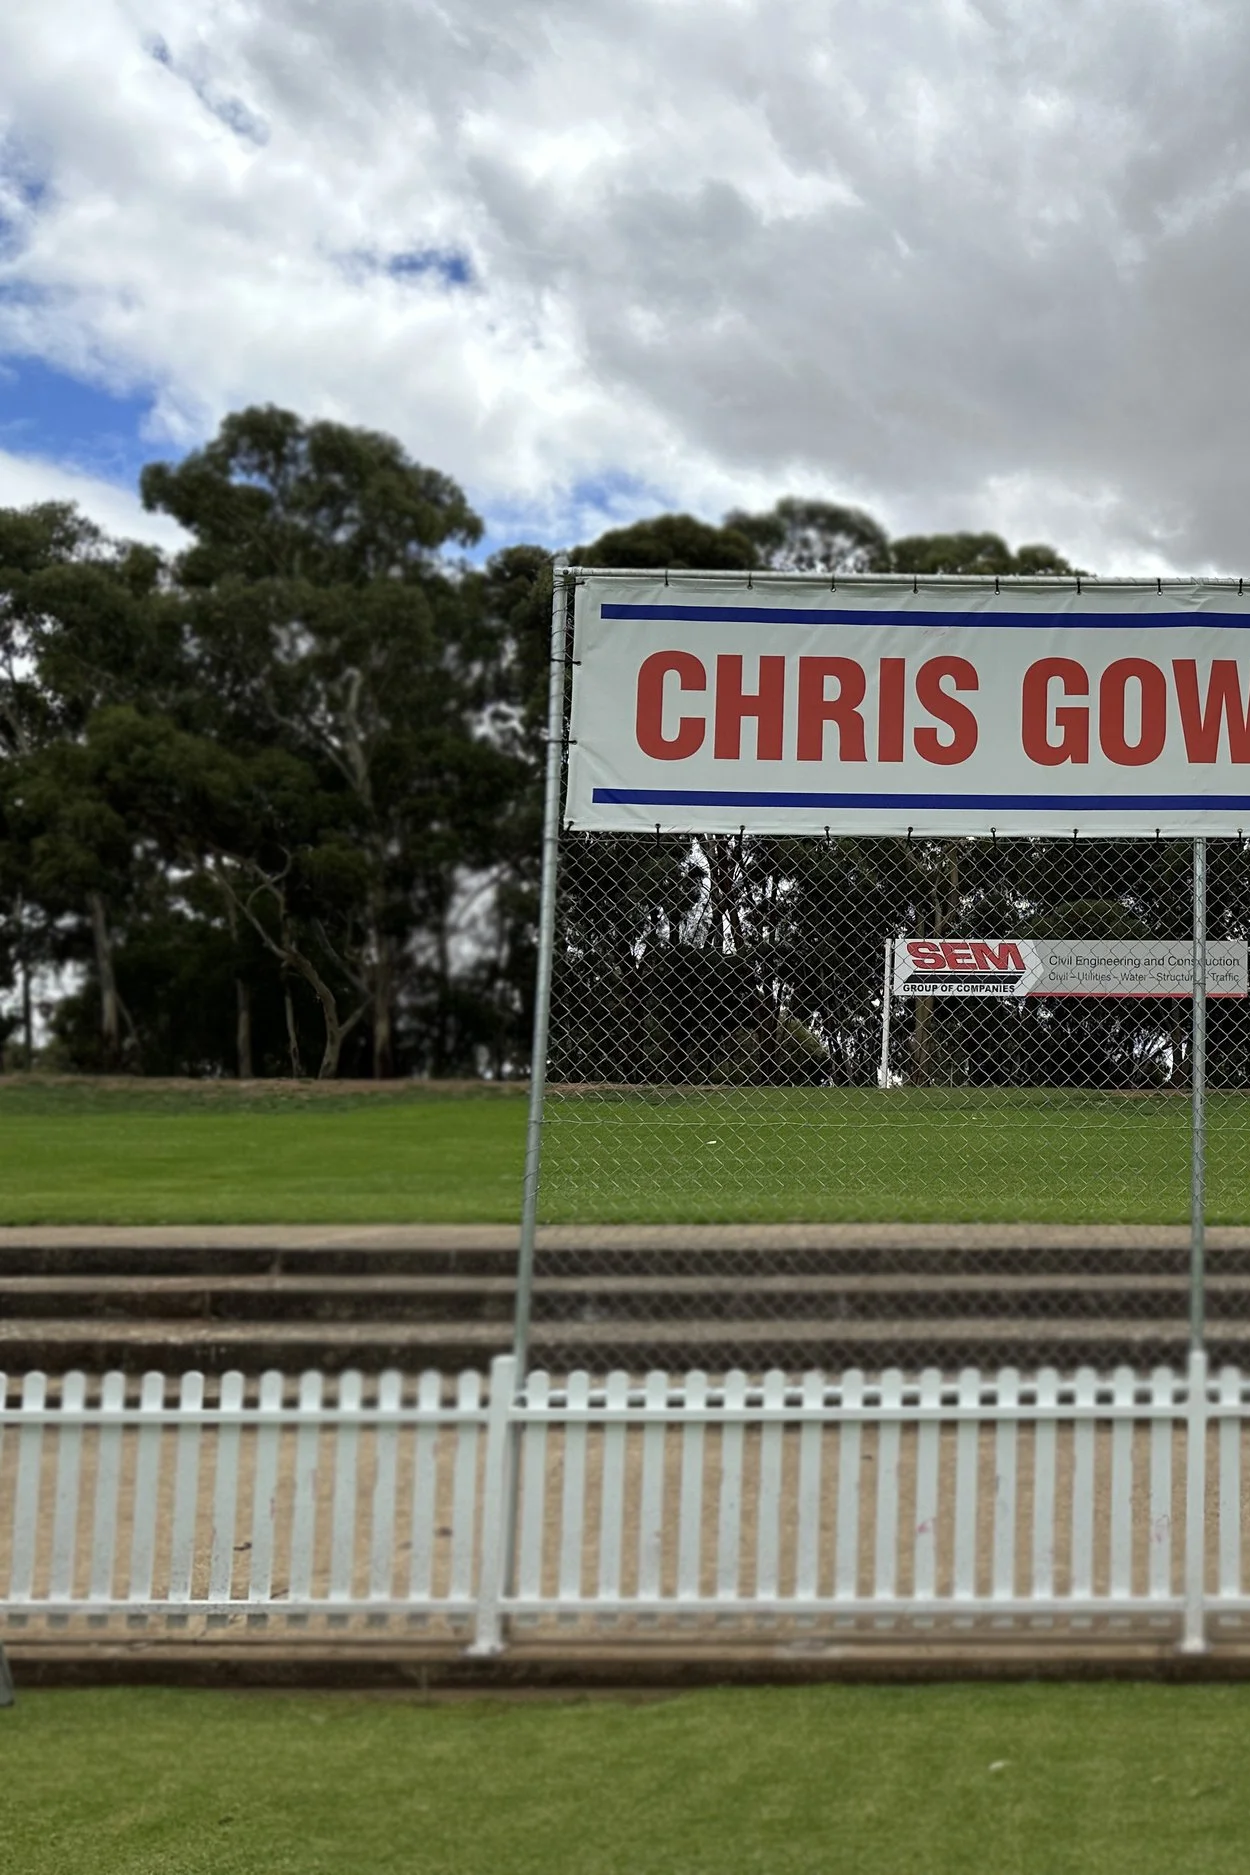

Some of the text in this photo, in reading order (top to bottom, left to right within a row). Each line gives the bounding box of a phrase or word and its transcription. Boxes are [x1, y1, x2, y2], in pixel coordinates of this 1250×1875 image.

[636, 650, 978, 766] CHRIS
[906, 942, 1027, 970] SEM
[1049, 955, 1240, 969] Civil Engineering and Consuction
[1049, 971, 1069, 981] Civil
[1120, 972, 1147, 982] Water
[1211, 972, 1240, 983] Traffic
[903, 984, 1016, 993] GROUP OF COMPANIES
